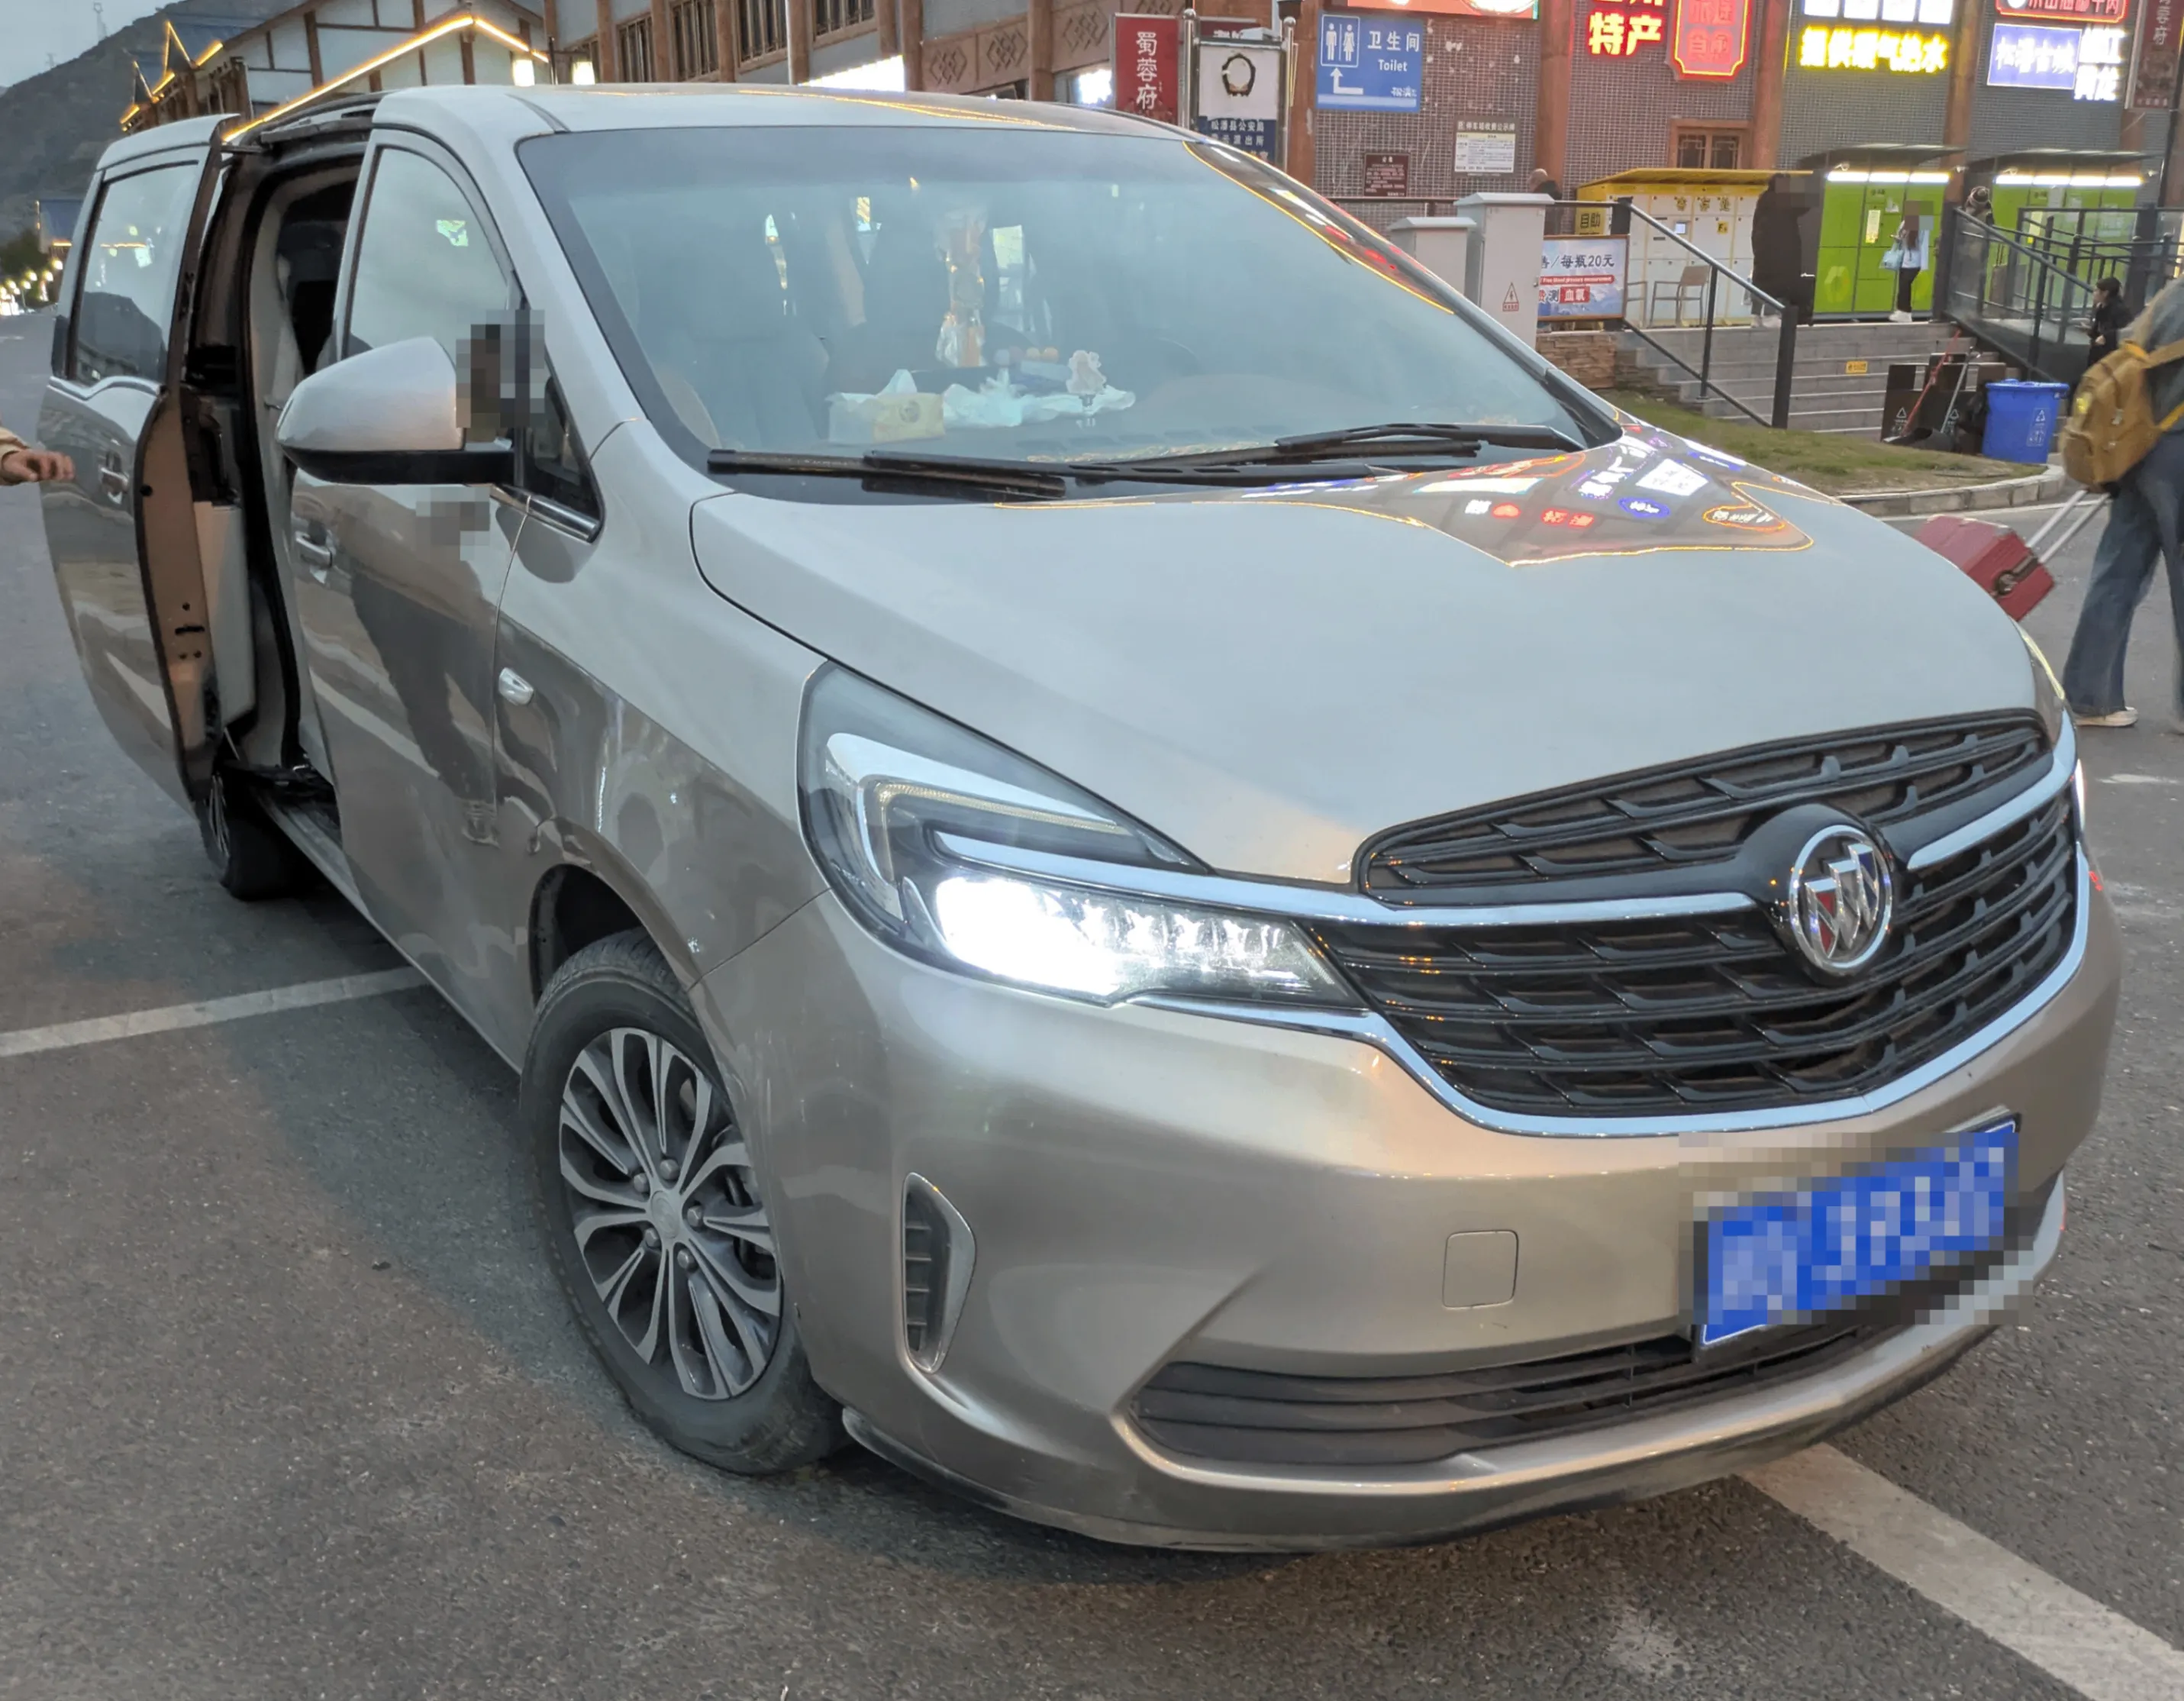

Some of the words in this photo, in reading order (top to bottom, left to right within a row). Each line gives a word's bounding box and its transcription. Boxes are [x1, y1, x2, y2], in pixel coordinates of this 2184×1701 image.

[1367, 31, 1420, 52] 卫生间
[1589, 12, 1662, 55] 特产
[1136, 31, 1157, 110] 蜀蓉府
[1378, 59, 1408, 72] Toilet
[1211, 119, 1265, 132] 松潘县公安局
[1580, 213, 1601, 229] 自助
